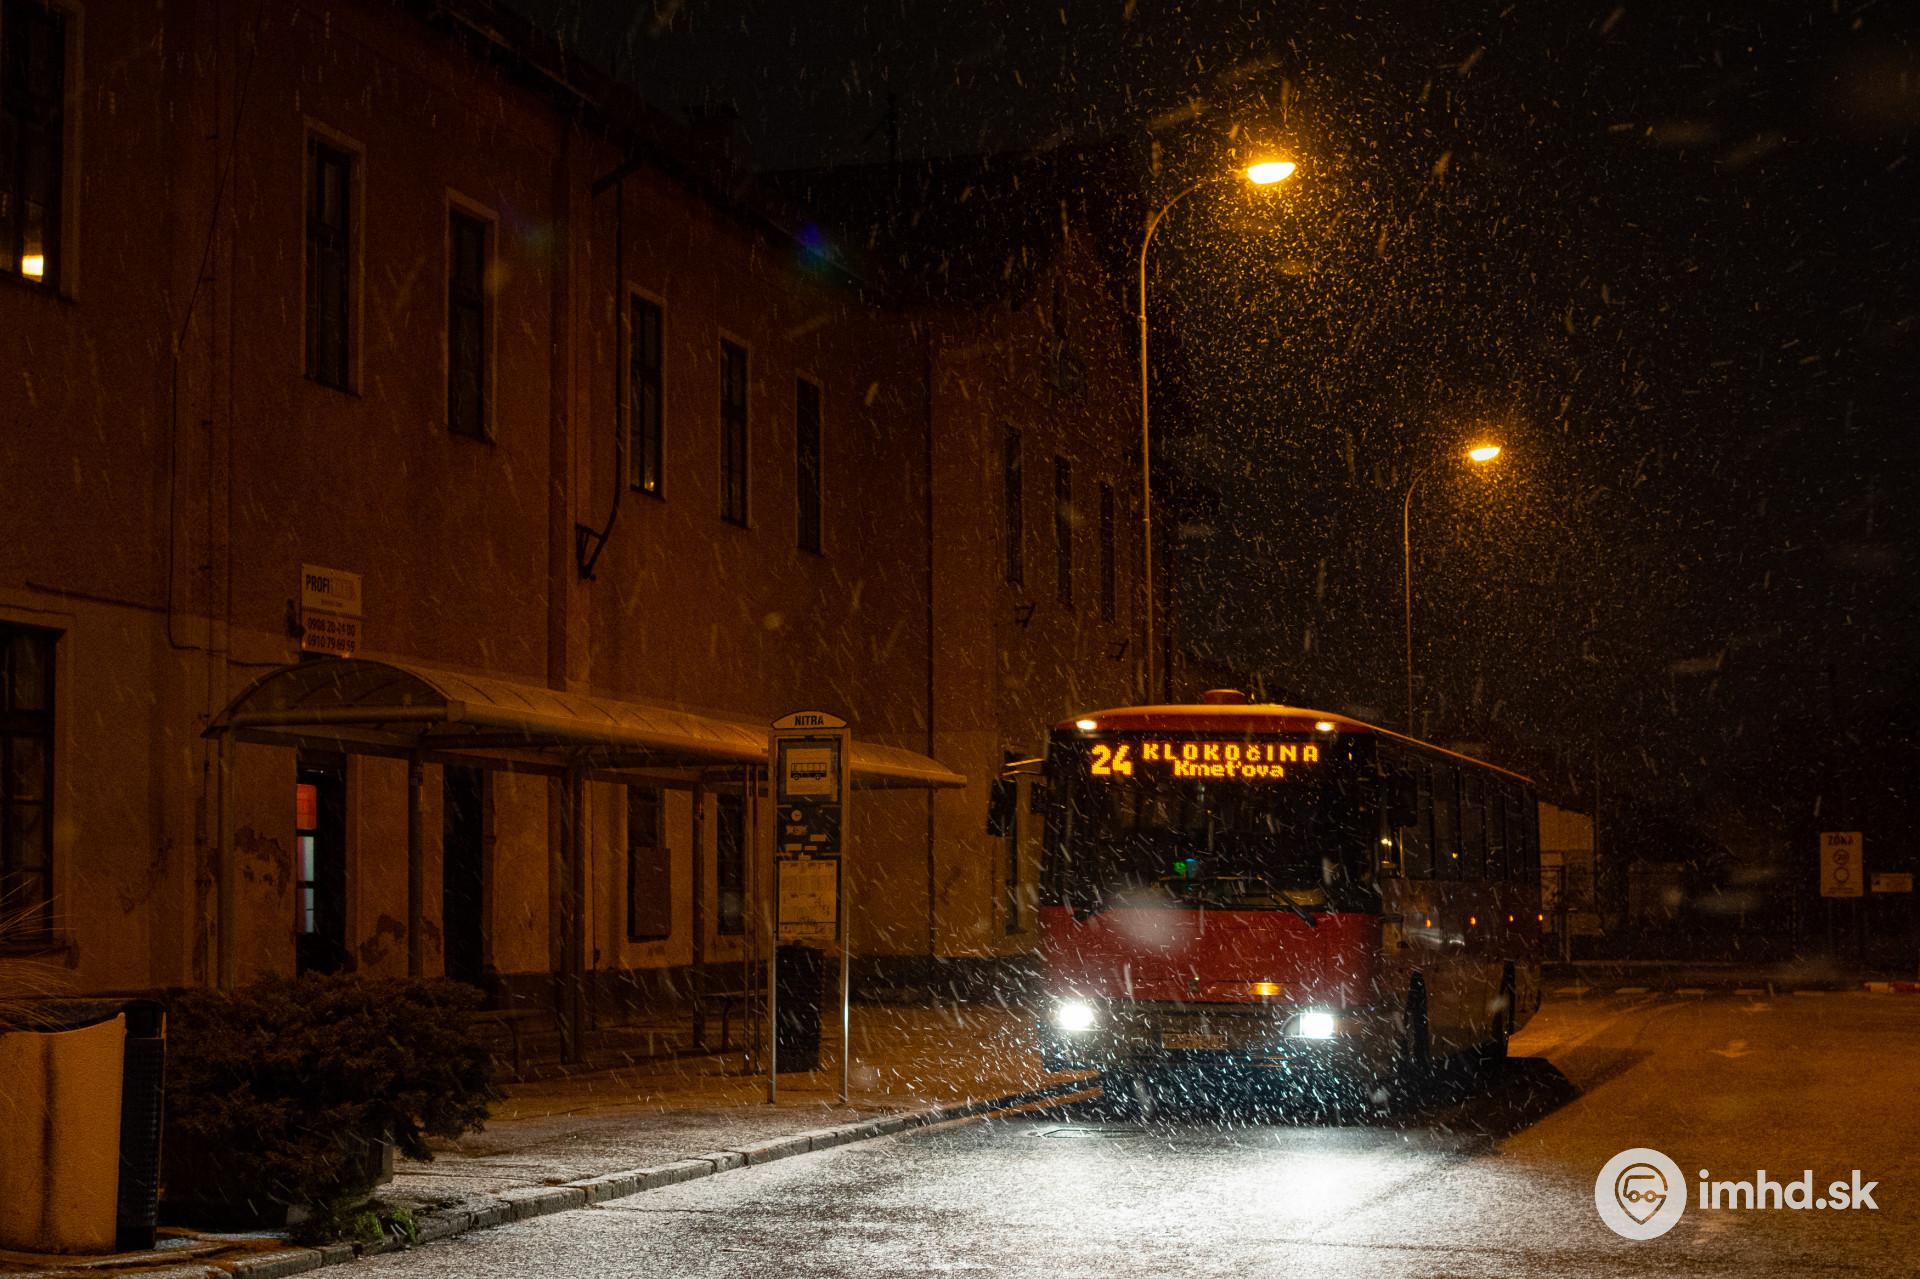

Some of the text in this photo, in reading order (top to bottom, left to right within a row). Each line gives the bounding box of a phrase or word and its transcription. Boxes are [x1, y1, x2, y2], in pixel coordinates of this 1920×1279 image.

[306, 574, 330, 593] PROFI
[795, 715, 824, 725] NITRA
[1091, 744, 1133, 776] 24
[1142, 743, 1319, 763] KLOKOČINA
[1173, 760, 1285, 778] Kmeťova
